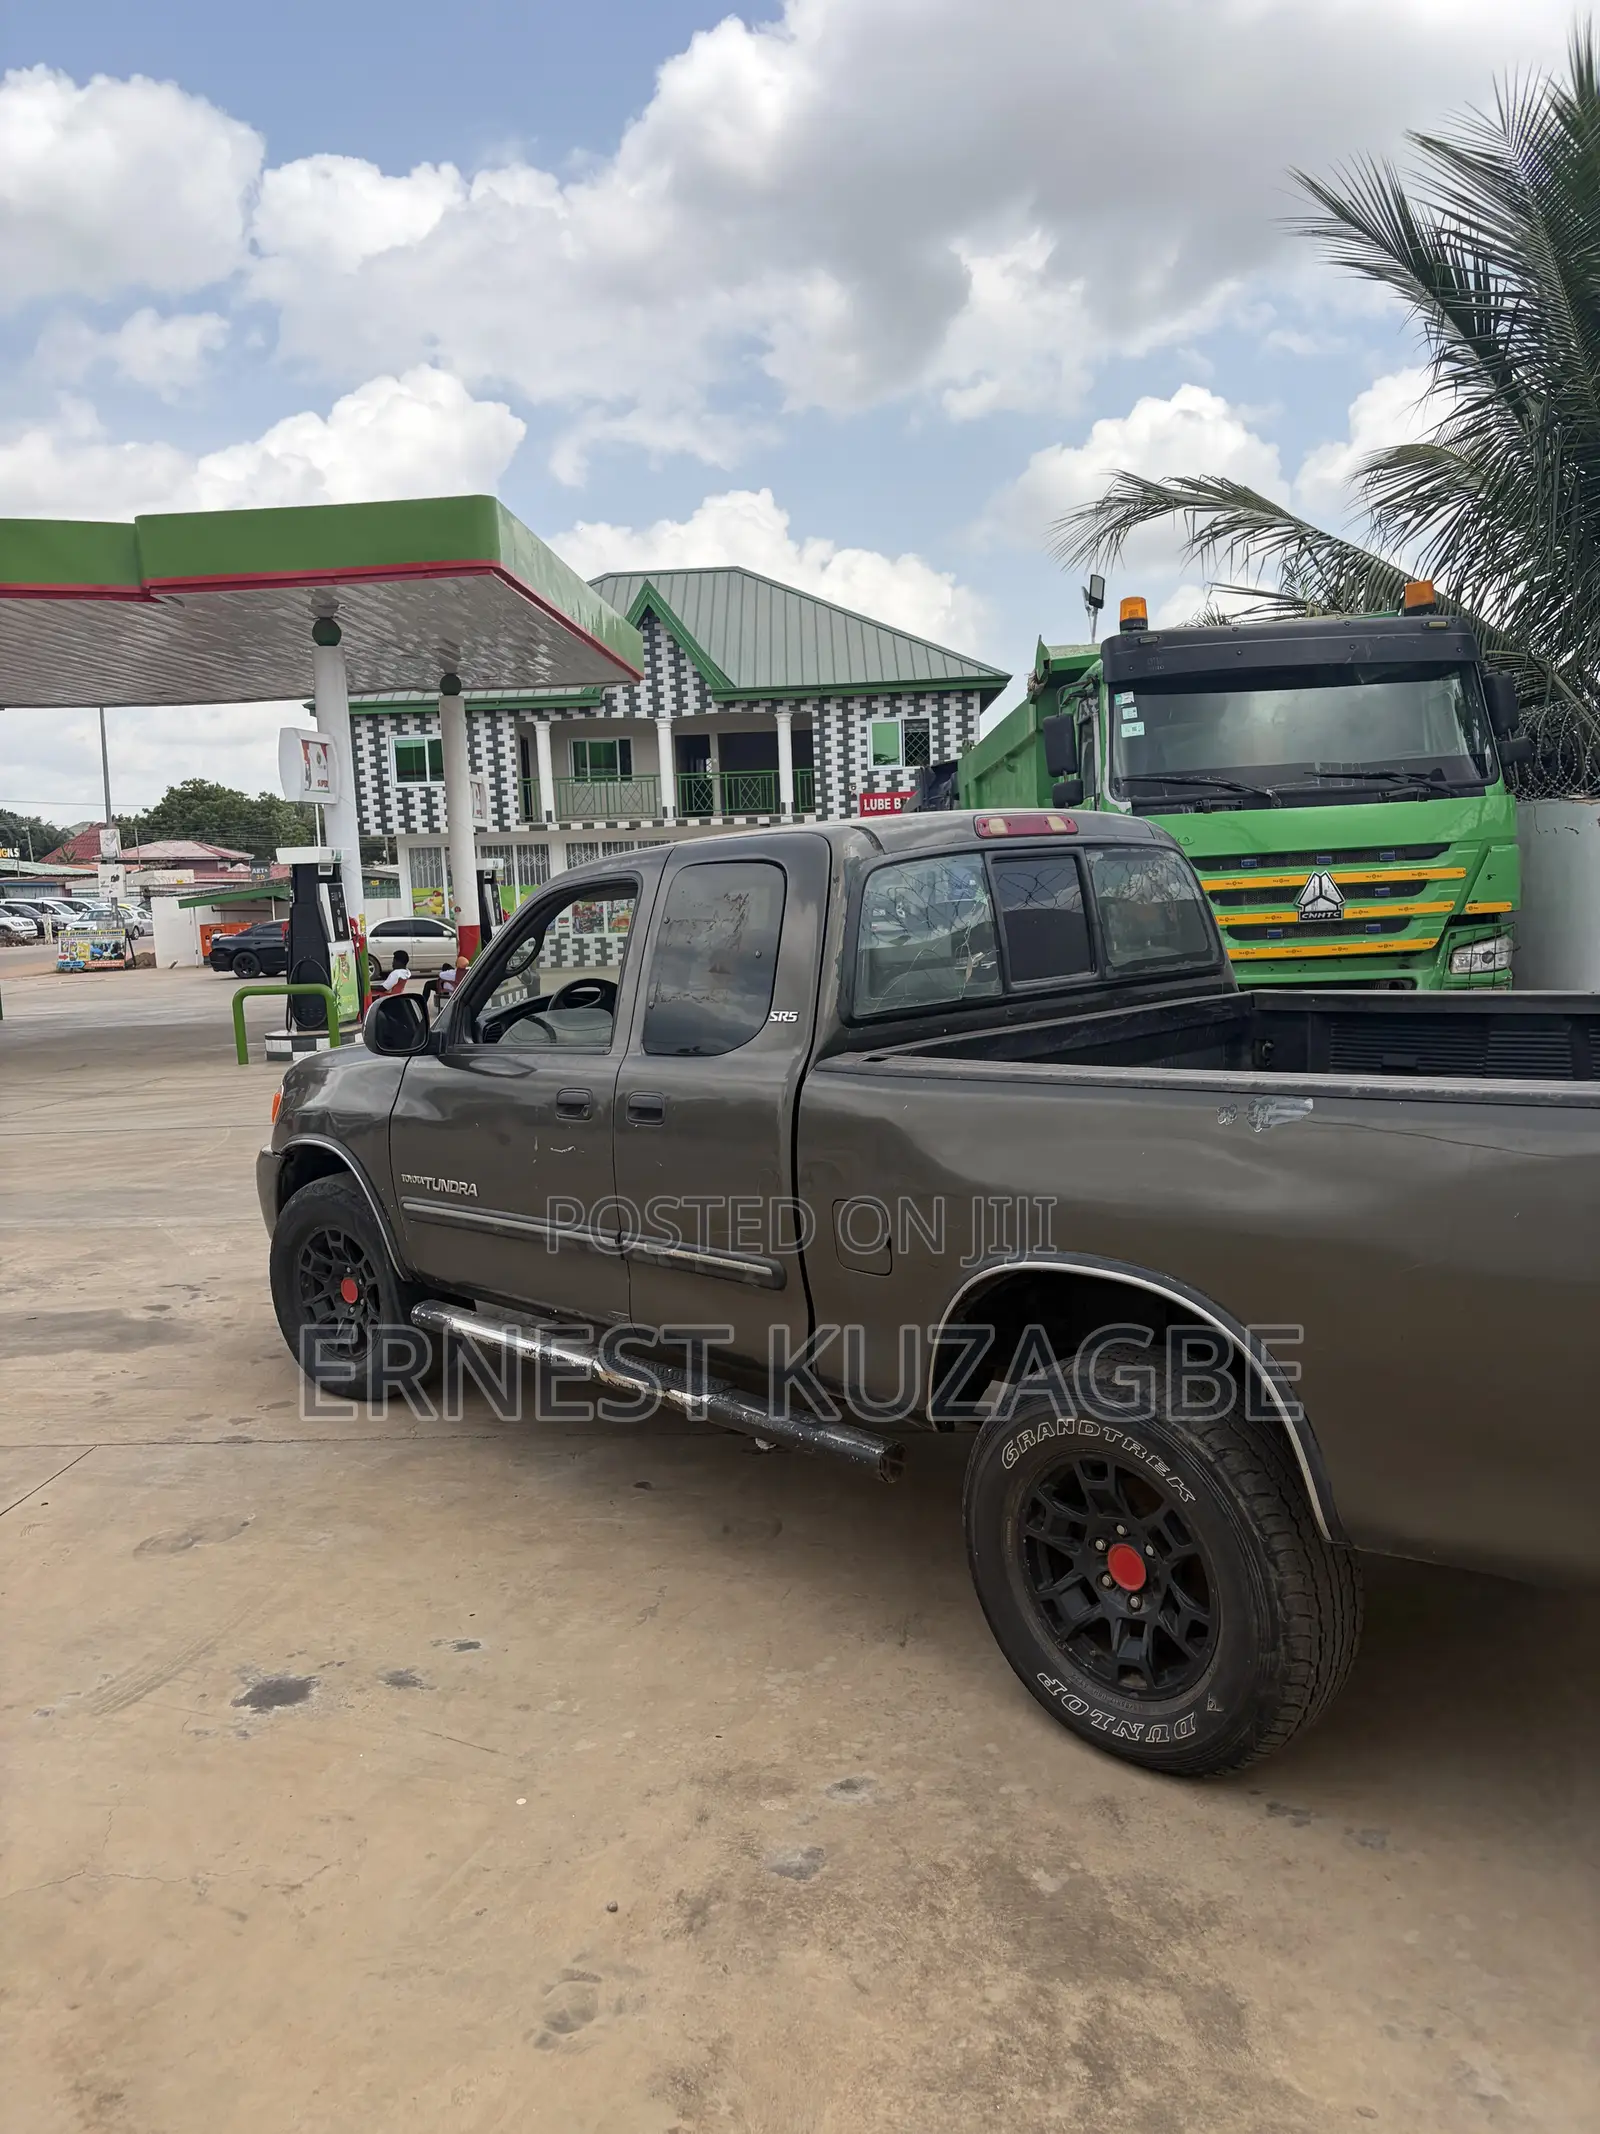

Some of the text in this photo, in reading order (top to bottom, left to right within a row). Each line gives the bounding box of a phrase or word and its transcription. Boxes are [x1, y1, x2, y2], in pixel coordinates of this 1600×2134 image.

[863, 798, 891, 811] LUBE
[1301, 911, 1341, 919] CNHTC
[769, 1010, 799, 1022] SR5
[401, 1173, 478, 1197] TOYOTA TUNDRA
[1001, 1418, 1196, 1503] GRANDTREK
[1036, 1672, 1197, 1743] DUNLOP
